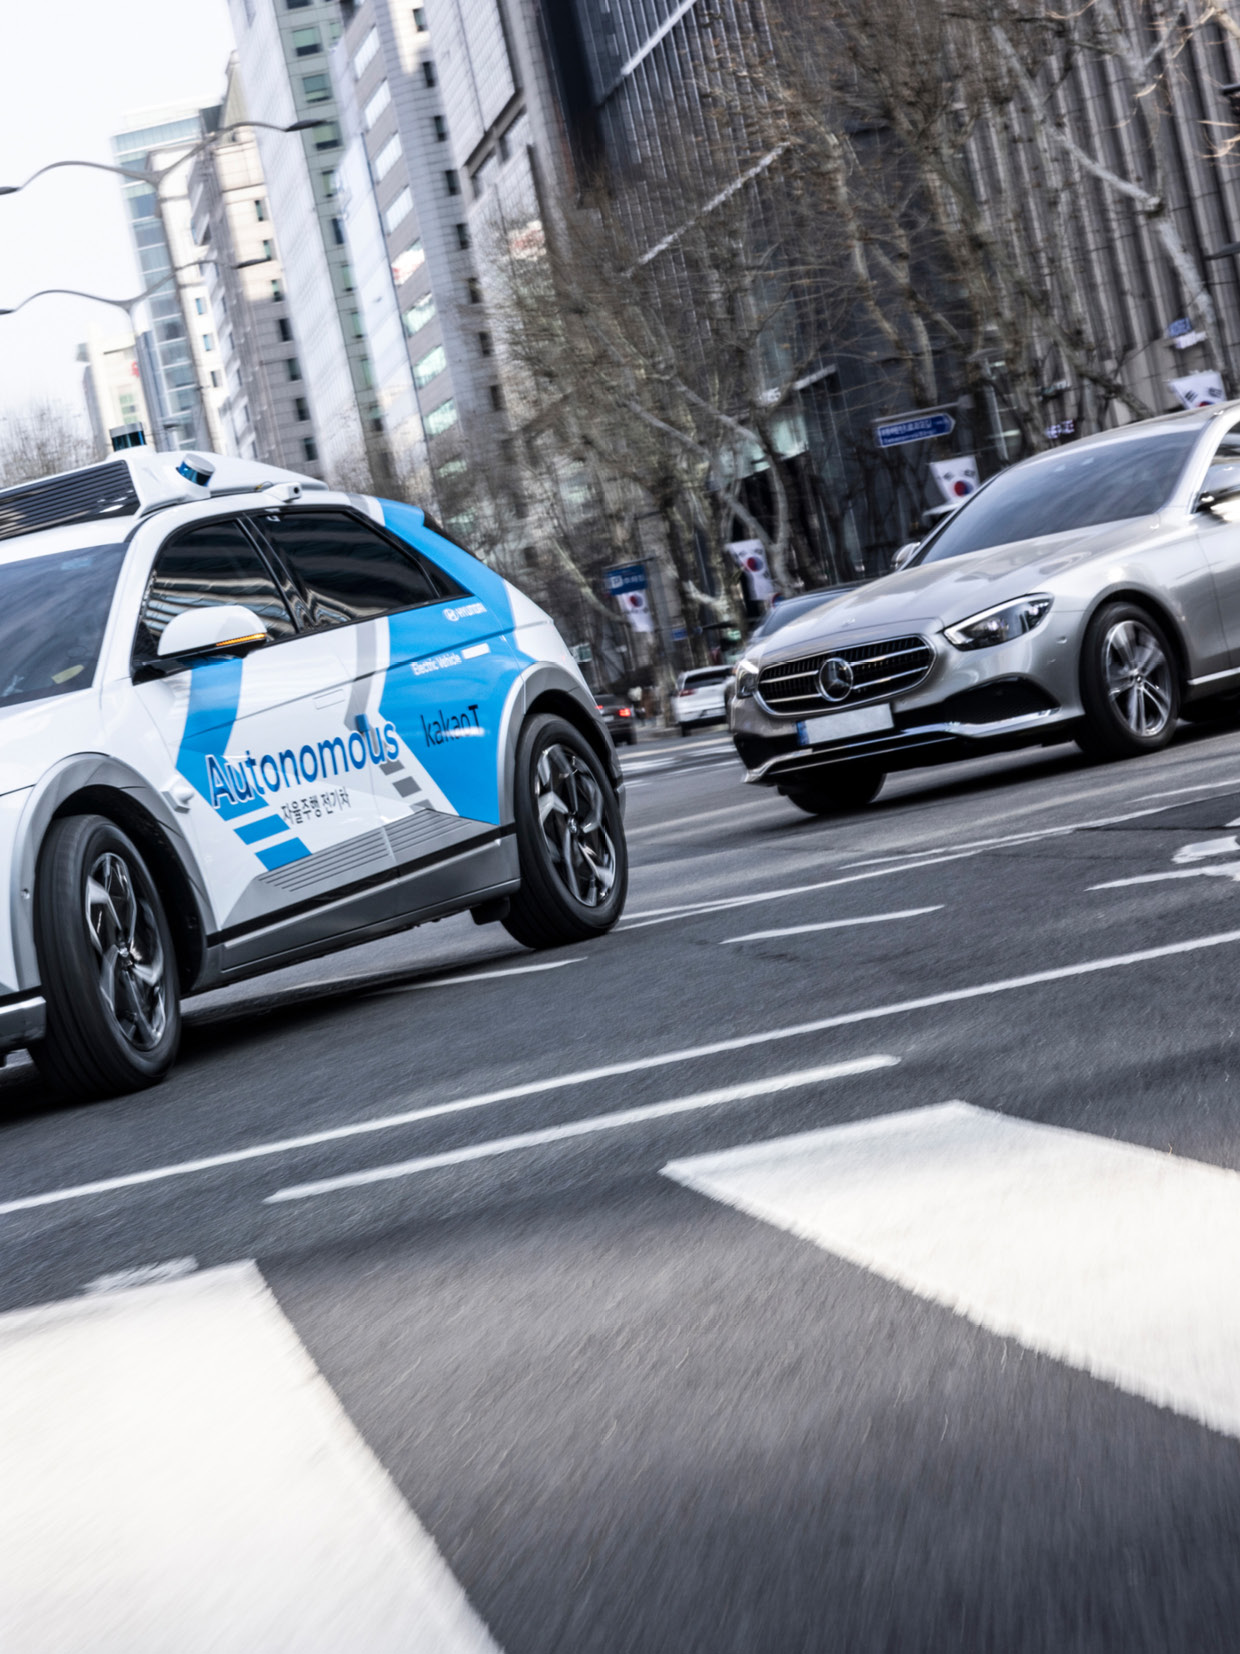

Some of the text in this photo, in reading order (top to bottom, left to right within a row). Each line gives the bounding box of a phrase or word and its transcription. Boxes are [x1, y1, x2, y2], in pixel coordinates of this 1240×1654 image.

[410, 652, 462, 676] Electric Vehicle
[205, 722, 400, 808] Autonomous
[281, 786, 351, 824] 자율주행 전기차
